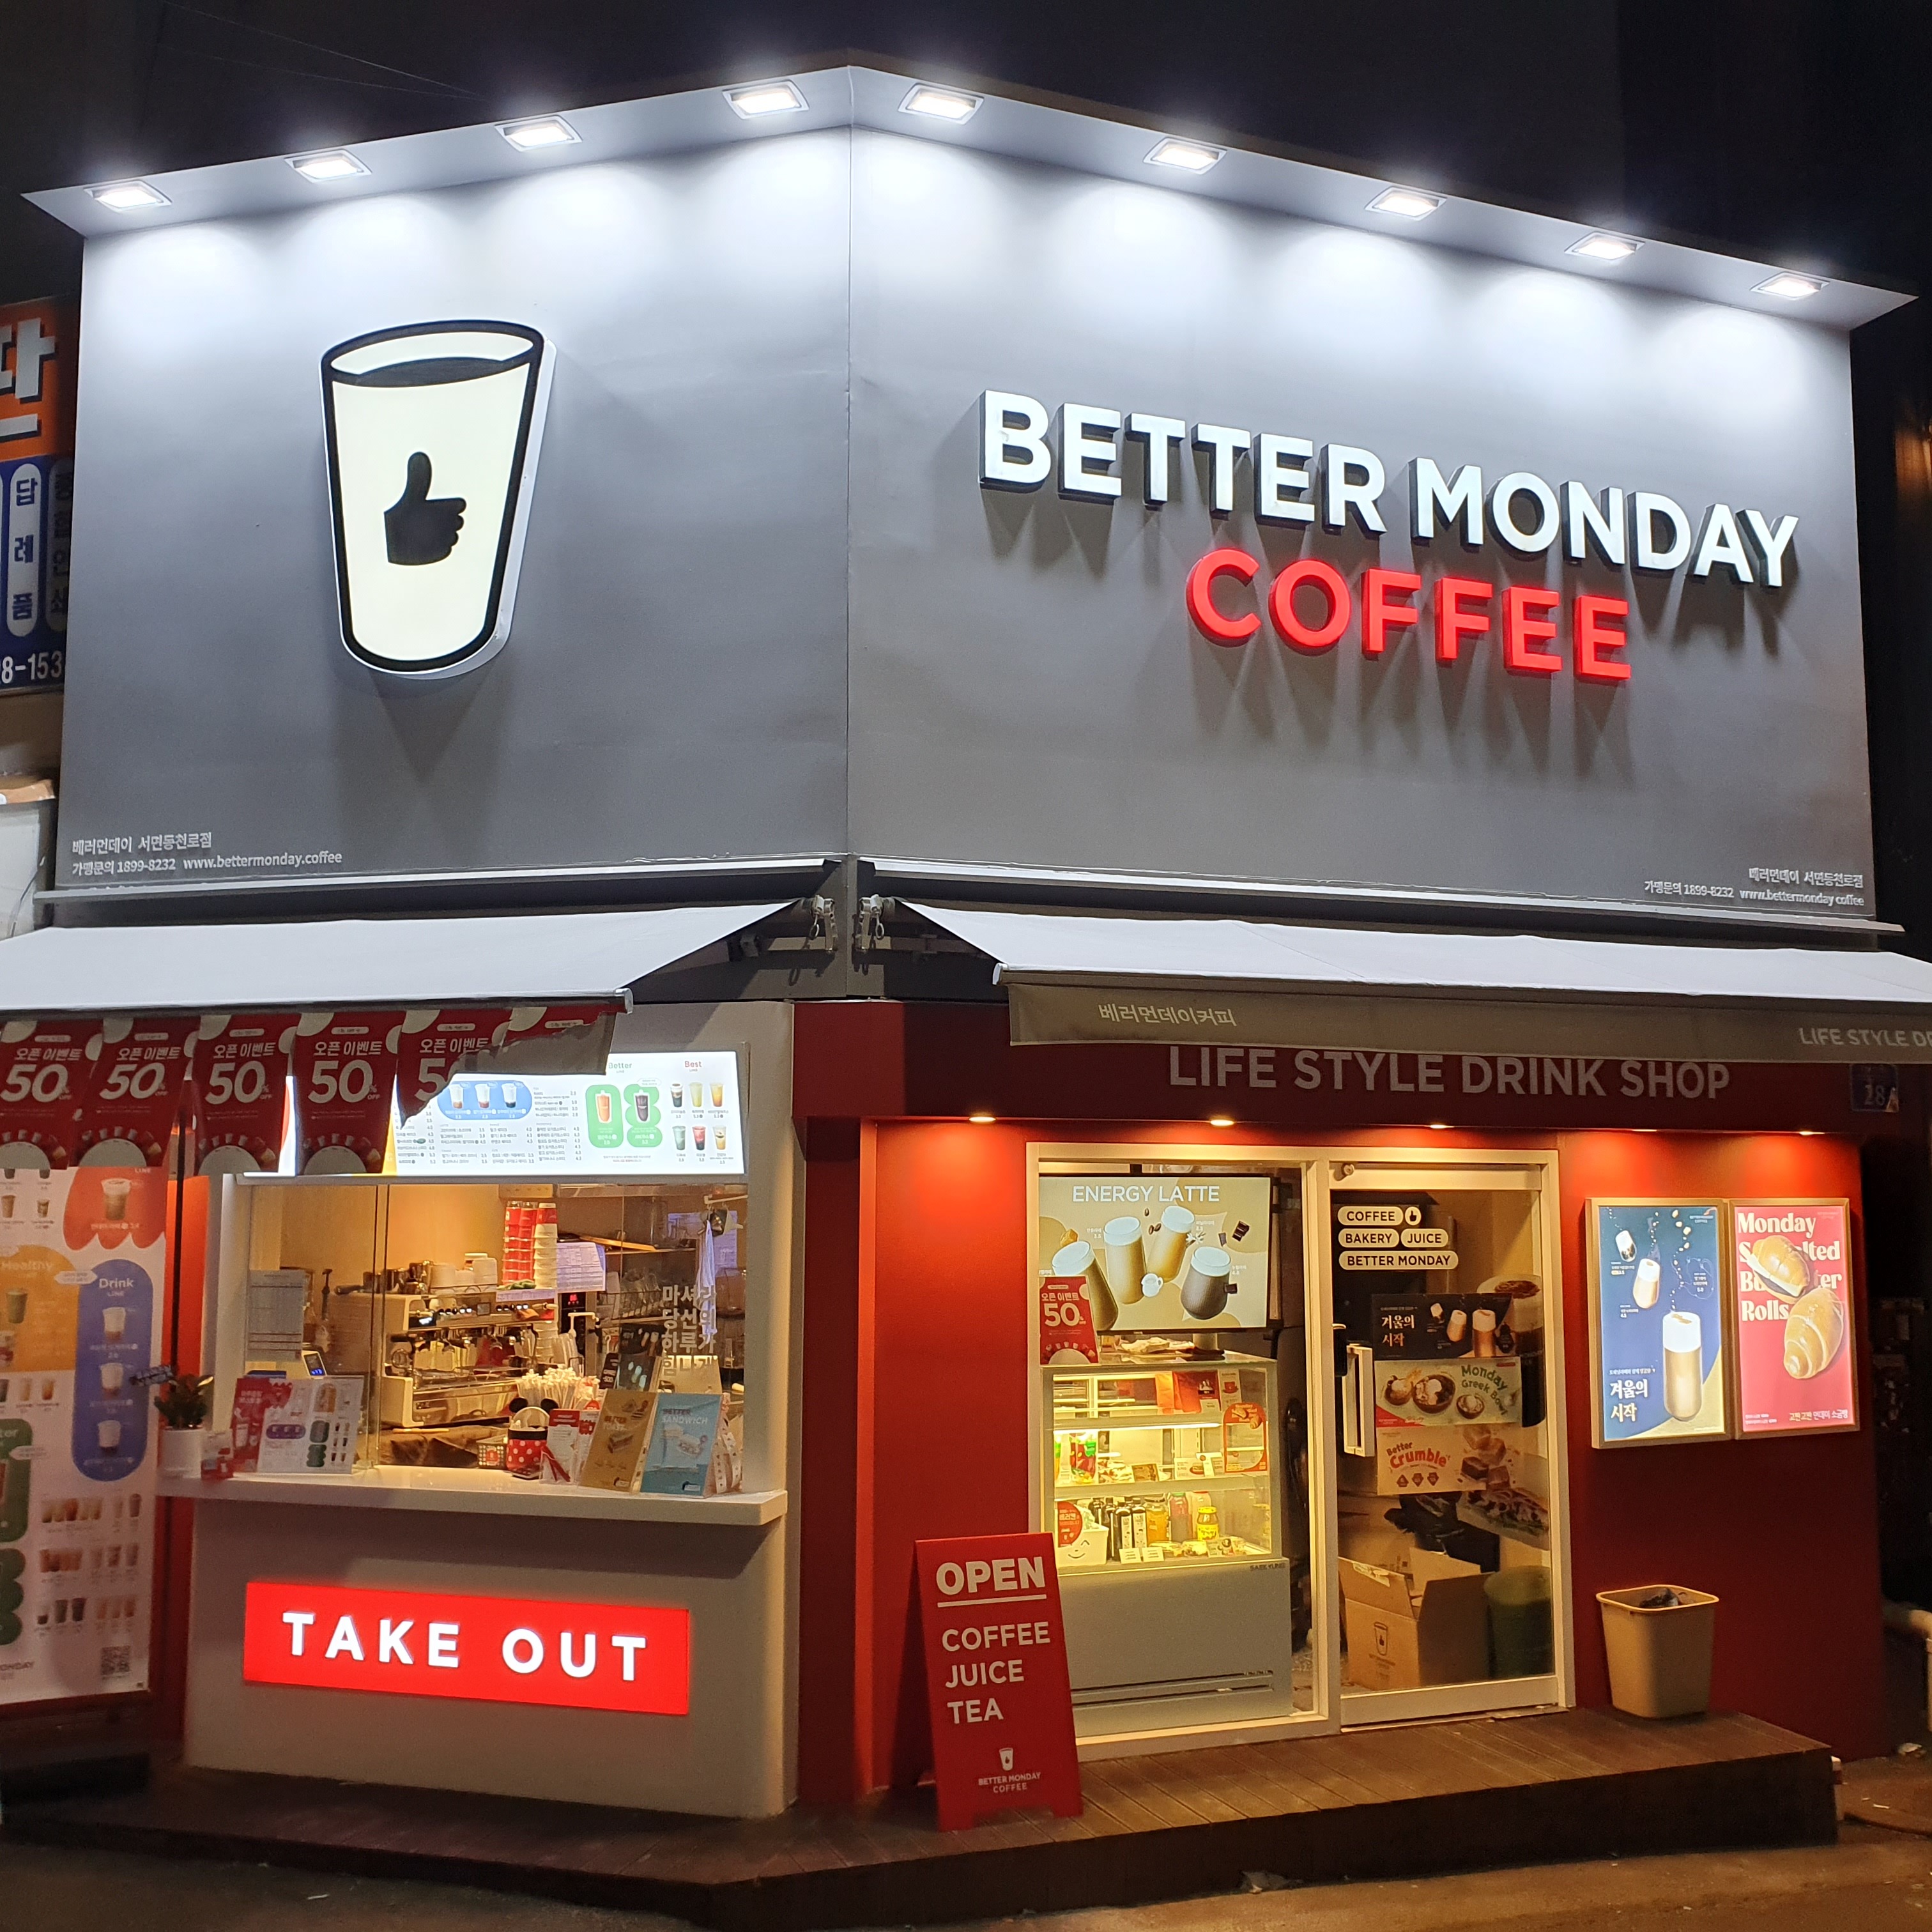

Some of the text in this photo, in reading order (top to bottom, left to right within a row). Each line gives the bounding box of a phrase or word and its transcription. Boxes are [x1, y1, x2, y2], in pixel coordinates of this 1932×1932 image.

[981, 389, 1799, 587] BETTER MONDAY
[13, 477, 37, 621] 답례품
[1186, 548, 1631, 680] COFFEE
[137, 832, 212, 852] 서면동천로점
[72, 851, 342, 876] 가맹문의 1899-8232 www.bettermonday.coffee
[1804, 871, 1864, 889] 서면동천로점
[1644, 880, 1865, 907] 가맹문의 1899-8232 www.bettermonday.coffee
[1098, 1002, 1238, 1027] 베러먼데이커피
[419, 1038, 447, 1054] 오픈
[1798, 1027, 1844, 1046] LIFE
[1846, 1029, 1910, 1047] STYLE
[14, 1048, 83, 1061] 오픈 이벤트
[116, 1046, 181, 1061] 오픈 이벤트
[213, 1042, 276, 1059] 오픈 이벤트
[314, 1041, 383, 1056] 오픈 이벤트
[1169, 1046, 1730, 1100] LIFE STYLE DRINK SHOP
[1072, 1185, 1220, 1202] ENERGY LATTE
[1346, 1211, 1395, 1222] COFFEE
[1737, 1212, 1817, 1239] Monday
[1345, 1233, 1442, 1244] BAKERY JUICE
[1347, 1255, 1451, 1266] BETTER MONDAY
[99, 1278, 134, 1289] Drink
[663, 1308, 715, 1330] 당신의
[1741, 1300, 1790, 1322] Rolls
[1381, 1314, 1414, 1330] 겨울의
[661, 1331, 716, 1353] 하루가
[1383, 1332, 1404, 1347] 시작
[1460, 1364, 1508, 1391] Monday
[1461, 1379, 1508, 1416] Greek Bowl
[1609, 1378, 1648, 1400] 겨울의
[661, 1416, 709, 1424] SANDWICH
[1611, 1402, 1638, 1423] 시작
[1386, 1442, 1413, 1456] Better
[936, 1556, 1046, 1596] OPEN
[282, 1611, 647, 1682] TAKE OUT
[942, 1621, 1051, 1652] COFFEE
[946, 1659, 1025, 1688] JUICE
[947, 1698, 1004, 1724] TEA
[978, 1772, 1041, 1786] BETTER MONDAY
[993, 1782, 1028, 1793] COFFEE
